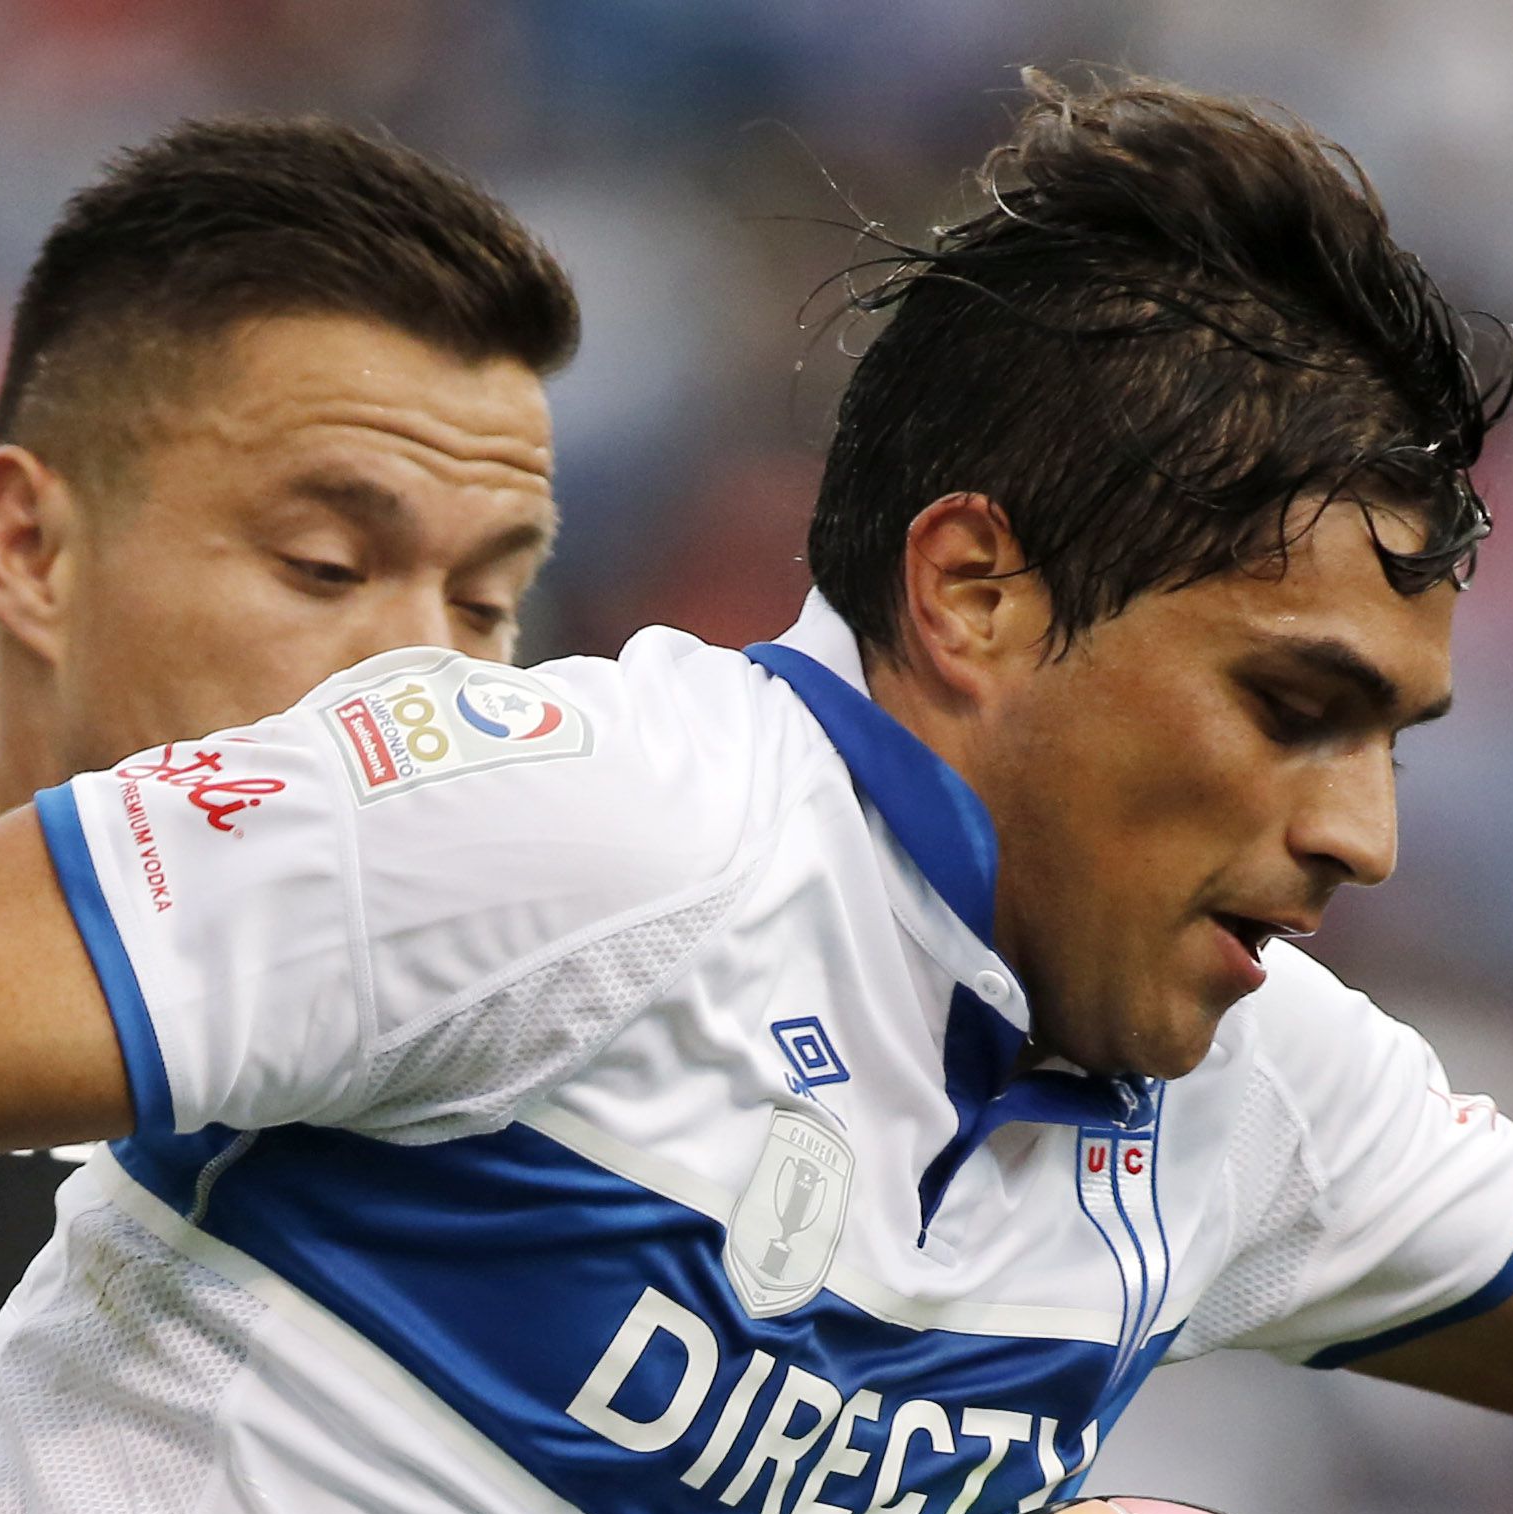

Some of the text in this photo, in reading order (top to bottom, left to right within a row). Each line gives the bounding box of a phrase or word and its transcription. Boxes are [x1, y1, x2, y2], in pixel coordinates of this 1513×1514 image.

[349, 716, 387, 779] Scotiabank
[365, 693, 414, 777] CAMPEONATO
[385, 683, 450, 762] 100
[119, 779, 173, 913] PREMIUM VODKA
[1088, 1146, 1143, 1175] U C
